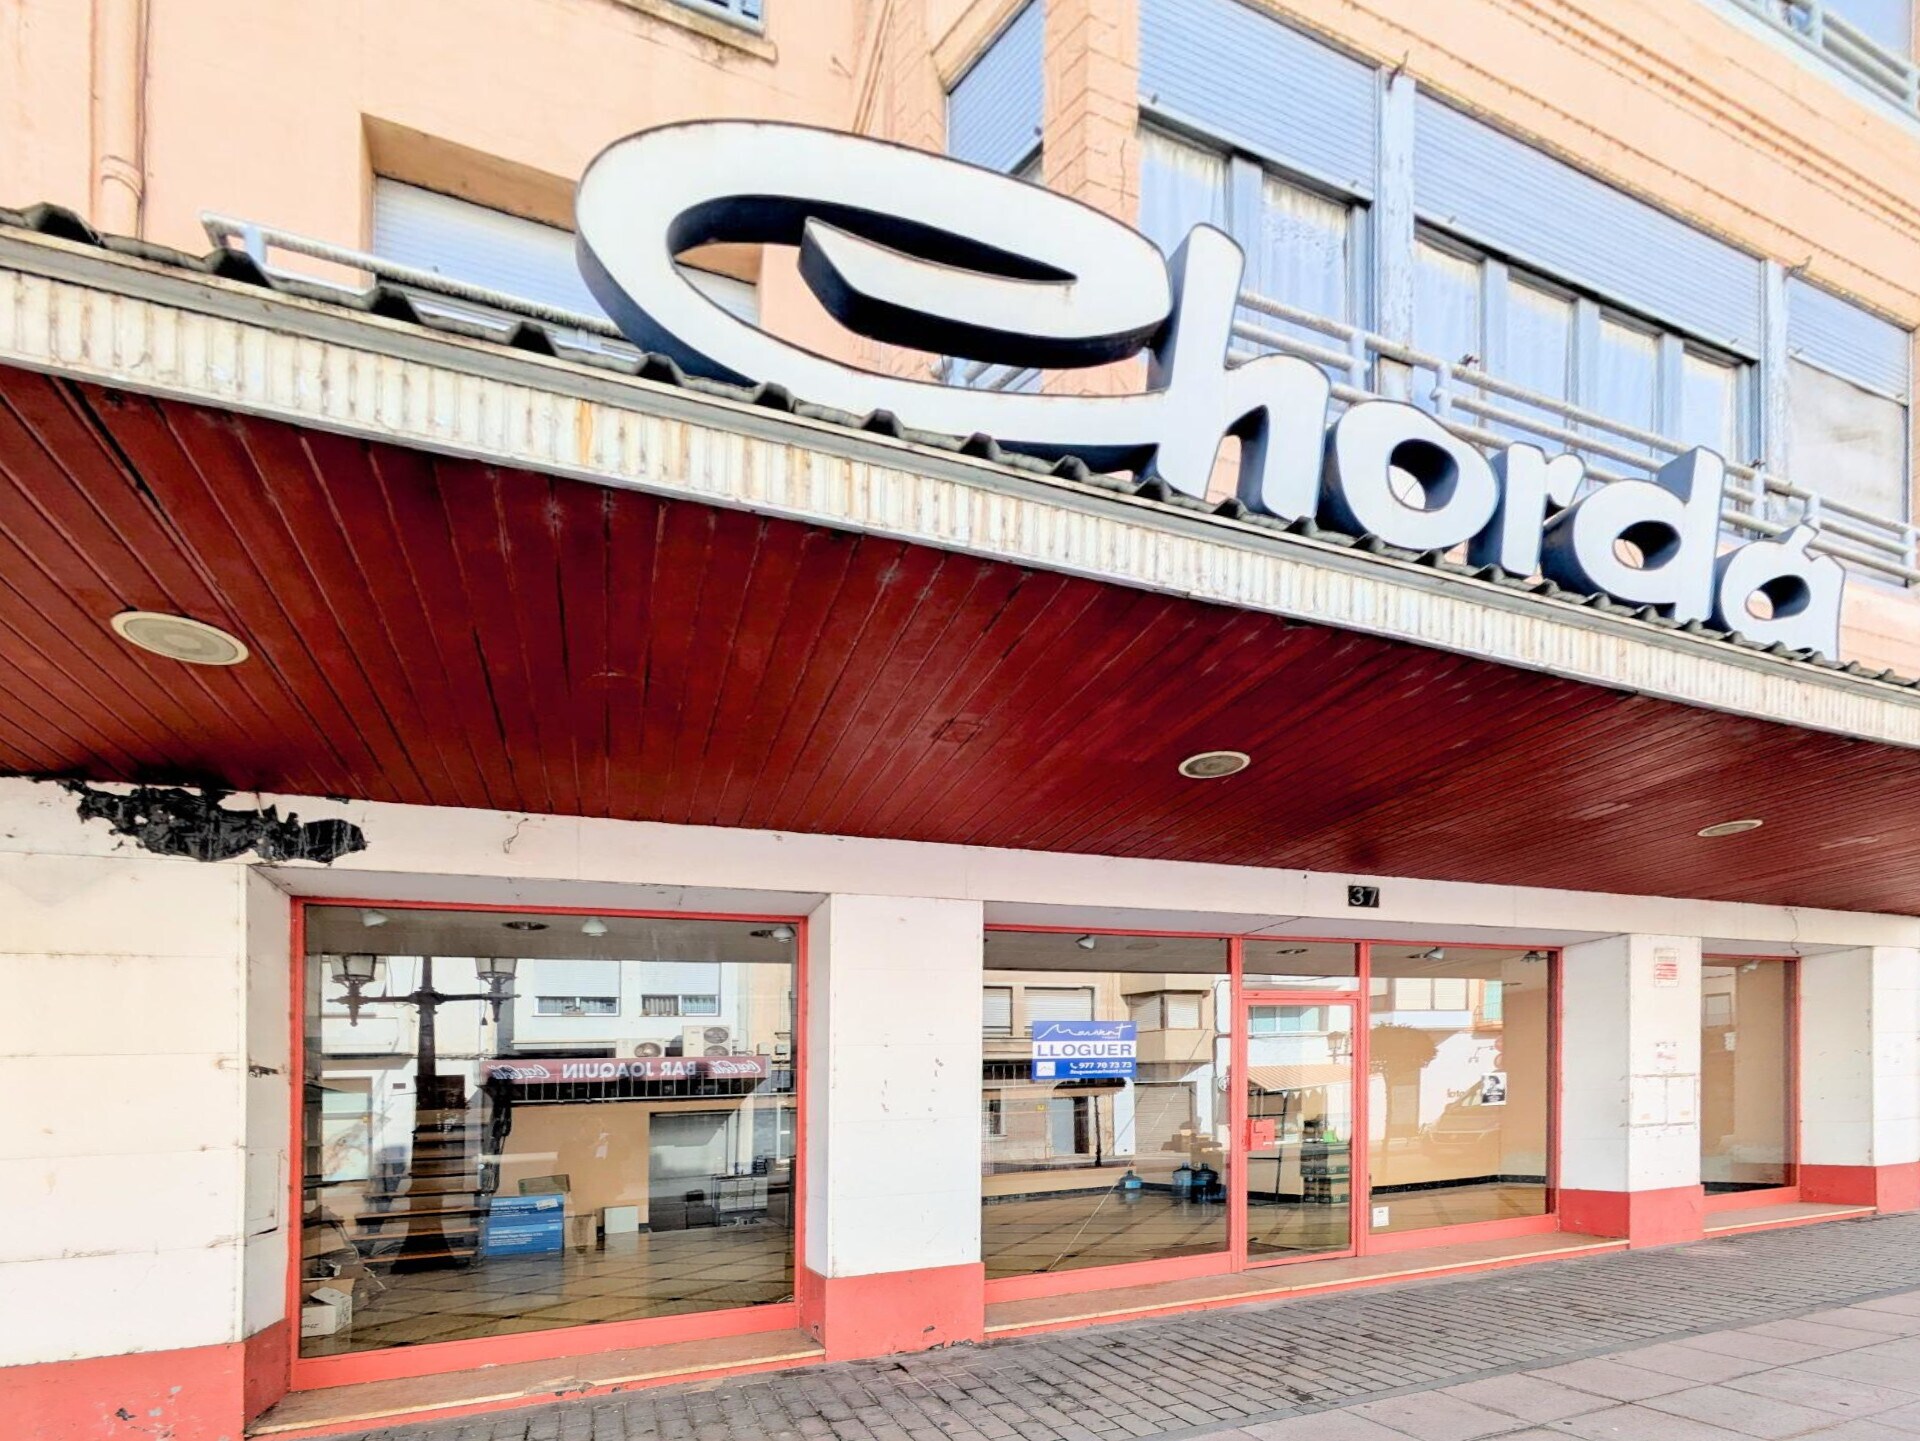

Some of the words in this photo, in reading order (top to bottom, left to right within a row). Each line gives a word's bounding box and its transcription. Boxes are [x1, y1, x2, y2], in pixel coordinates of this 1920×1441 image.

[576, 119, 1845, 662] Chordá
[1351, 887, 1378, 906] 37
[1037, 1043, 1132, 1057] LLOGUER
[1078, 1061, 1095, 1069] 977
